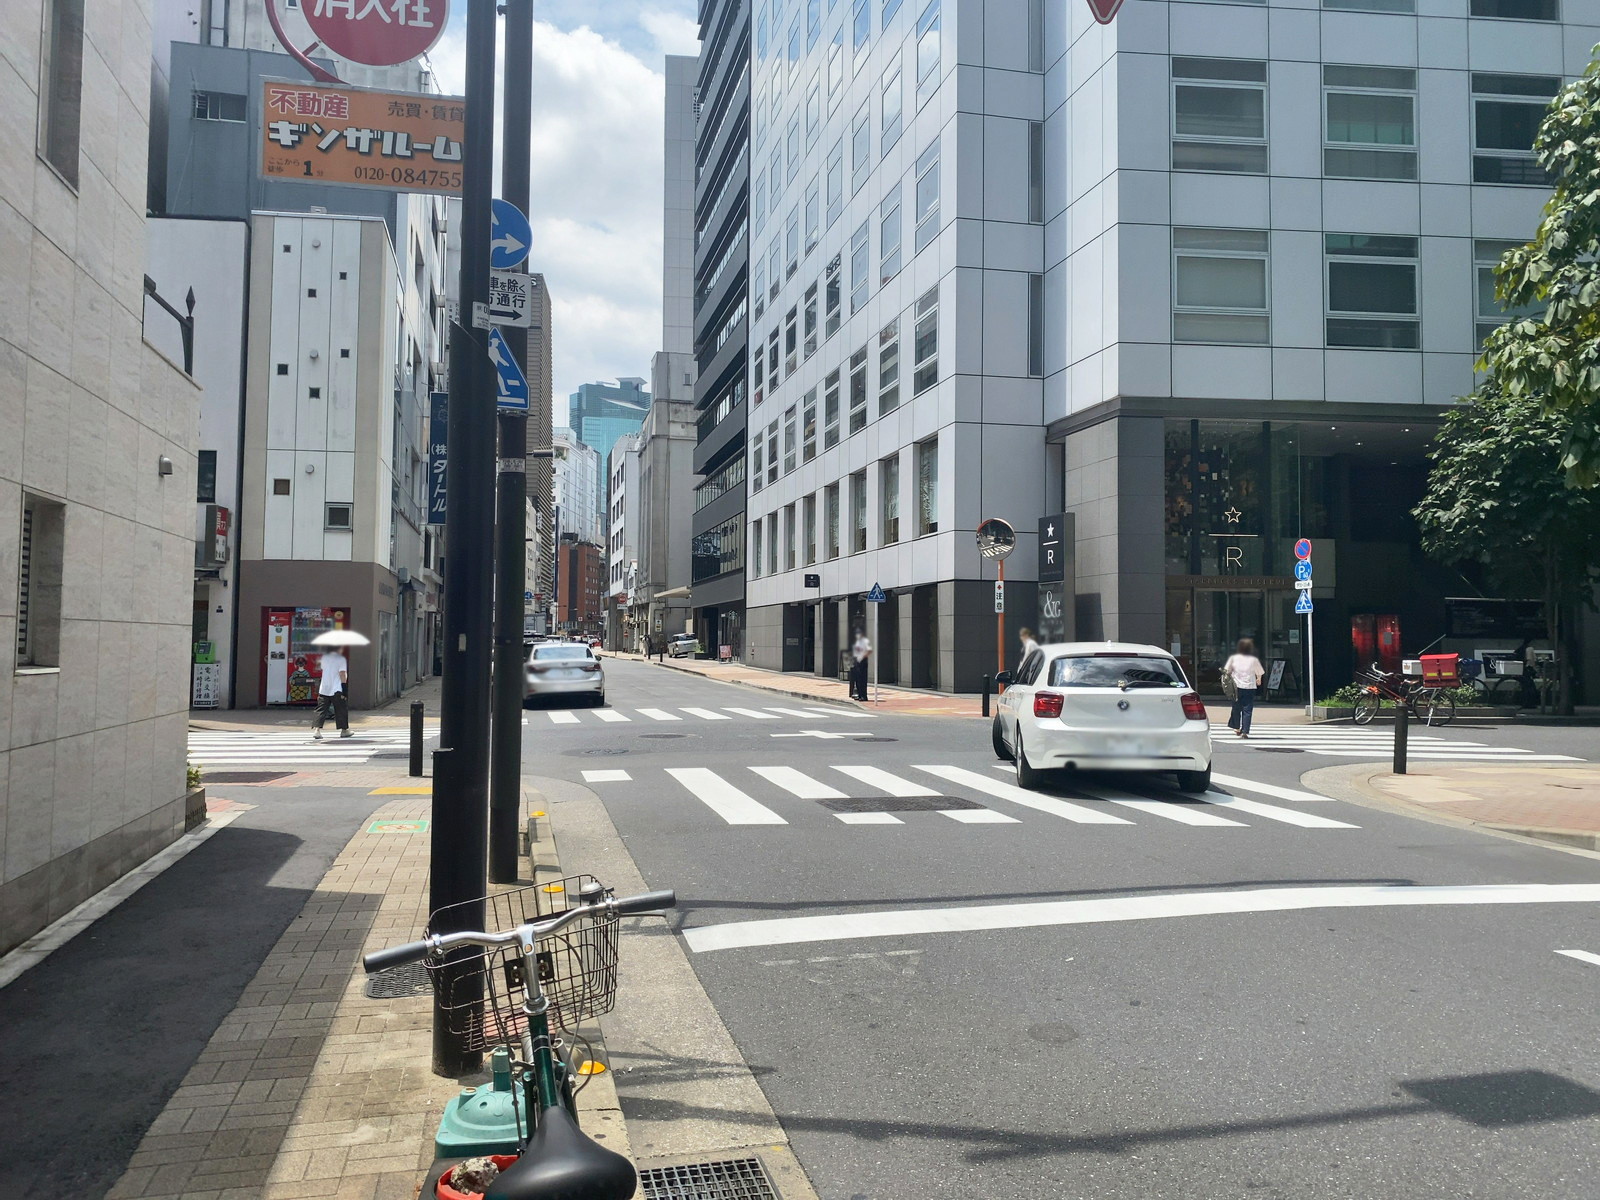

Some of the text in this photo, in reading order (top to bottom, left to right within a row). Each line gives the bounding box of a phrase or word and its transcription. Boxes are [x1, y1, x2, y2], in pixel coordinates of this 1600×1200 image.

[269, 88, 349, 120] 不動産
[268, 120, 463, 162] ギンザルーム
[303, 160, 313, 177] 1
[354, 166, 461, 187] 0120-084755
[489, 292, 526, 309] 通行
[432, 459, 447, 512] タートル
[1047, 549, 1054, 565] R
[1226, 546, 1243, 568] R
[1298, 565, 1306, 579] P
